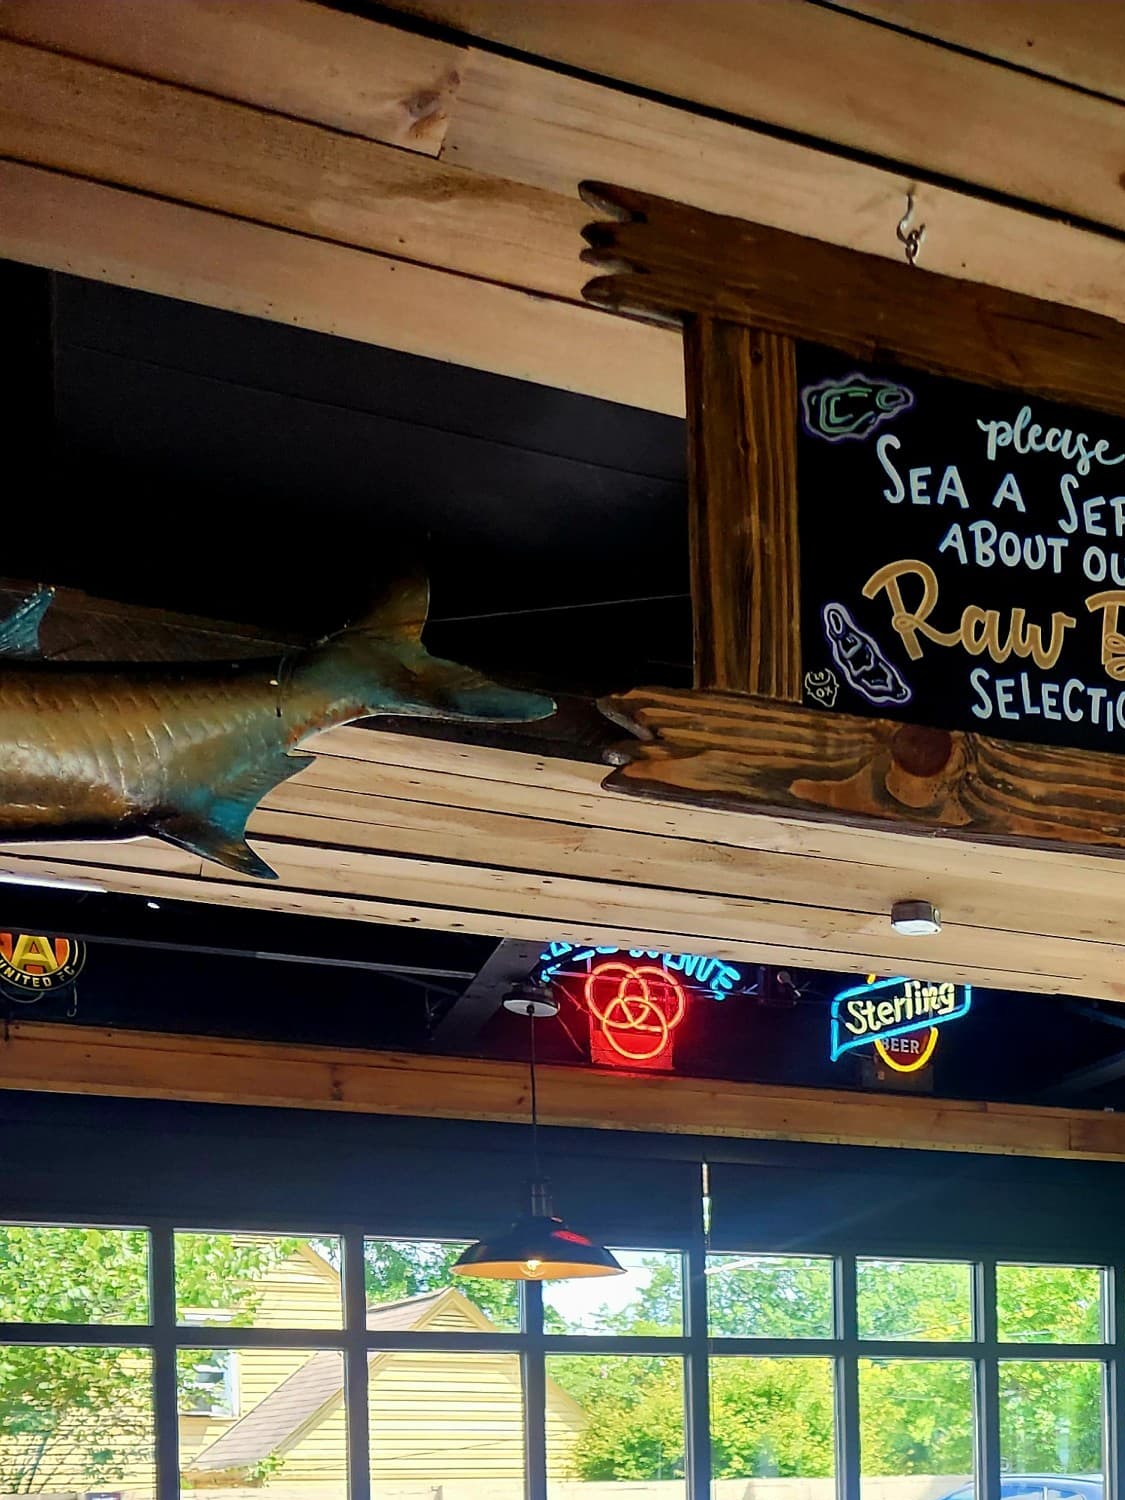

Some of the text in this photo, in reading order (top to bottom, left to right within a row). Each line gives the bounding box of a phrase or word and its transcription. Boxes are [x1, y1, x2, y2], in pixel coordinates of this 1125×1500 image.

[876, 434, 969, 509] SEA
[992, 473, 1026, 512] A
[939, 519, 1068, 573] ABOUT
[861, 559, 1076, 670] Raw
[845, 978, 955, 1035] Sterling
[882, 1037, 921, 1055] BEER
